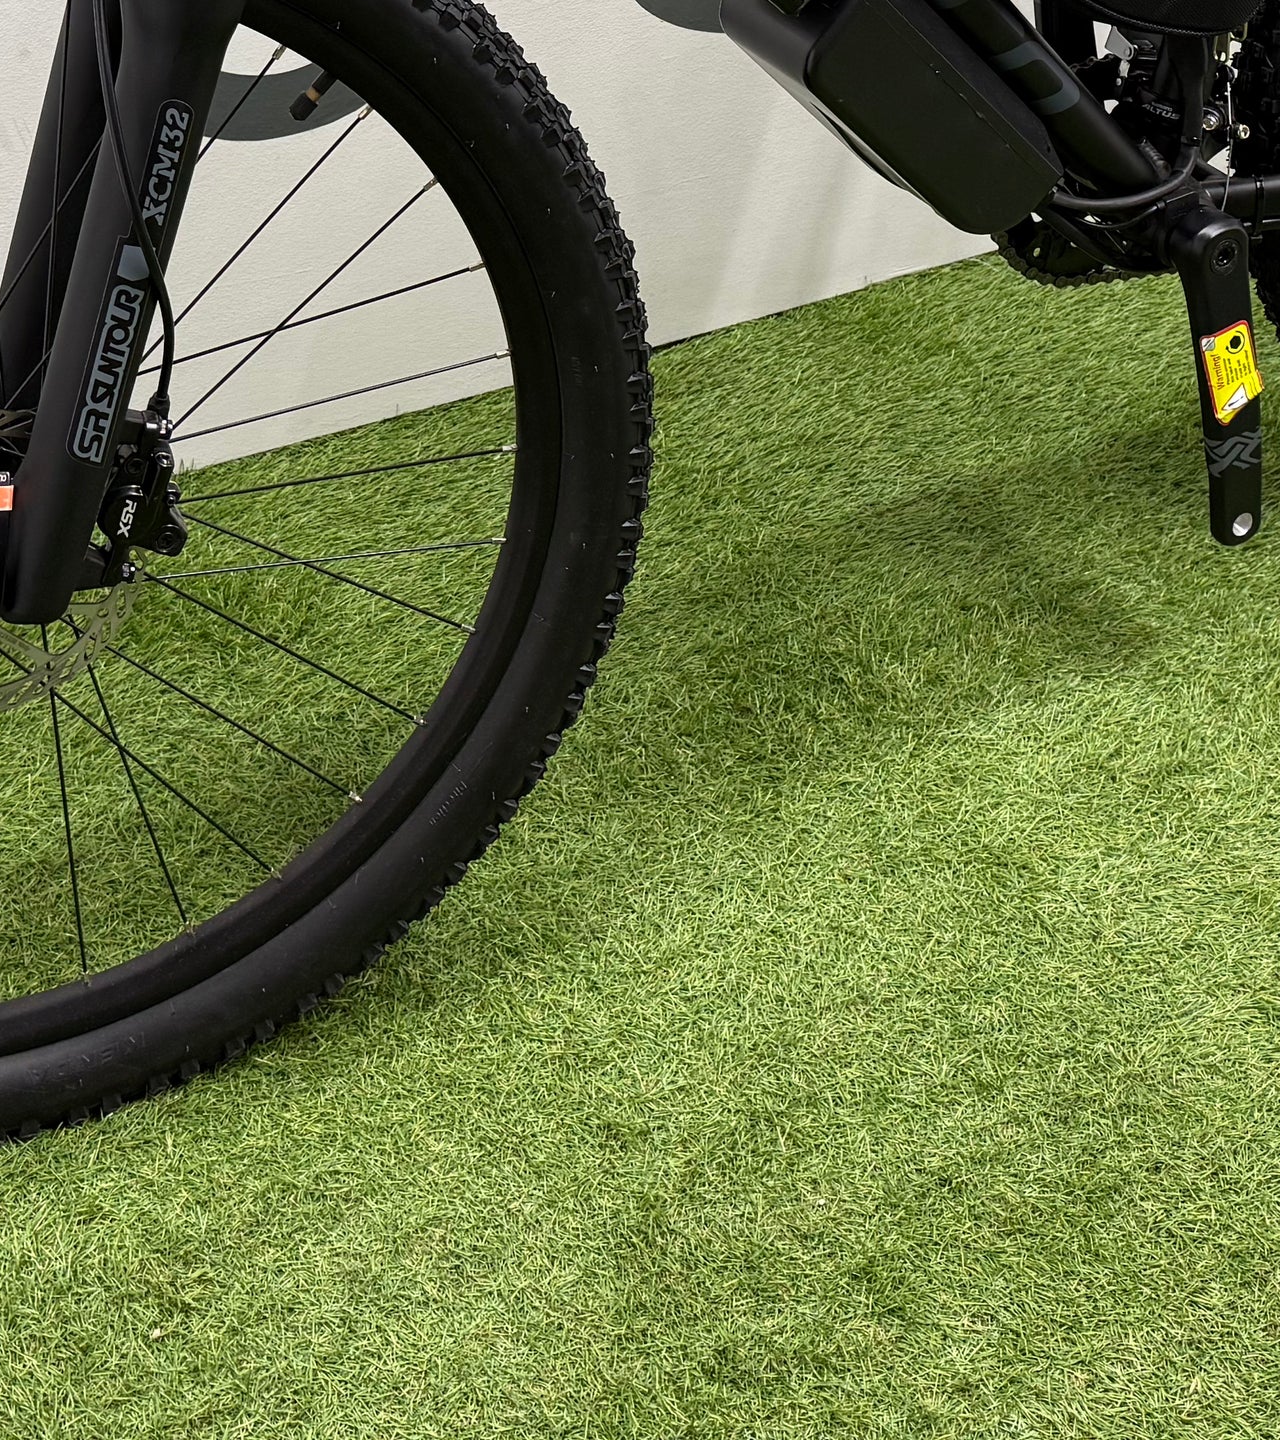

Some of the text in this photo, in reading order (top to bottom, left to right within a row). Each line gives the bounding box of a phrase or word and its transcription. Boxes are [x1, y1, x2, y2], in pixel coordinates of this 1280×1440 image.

[1141, 103, 1181, 120] ALTUS
[142, 106, 190, 227] XCM32
[116, 499, 138, 538] RSX
